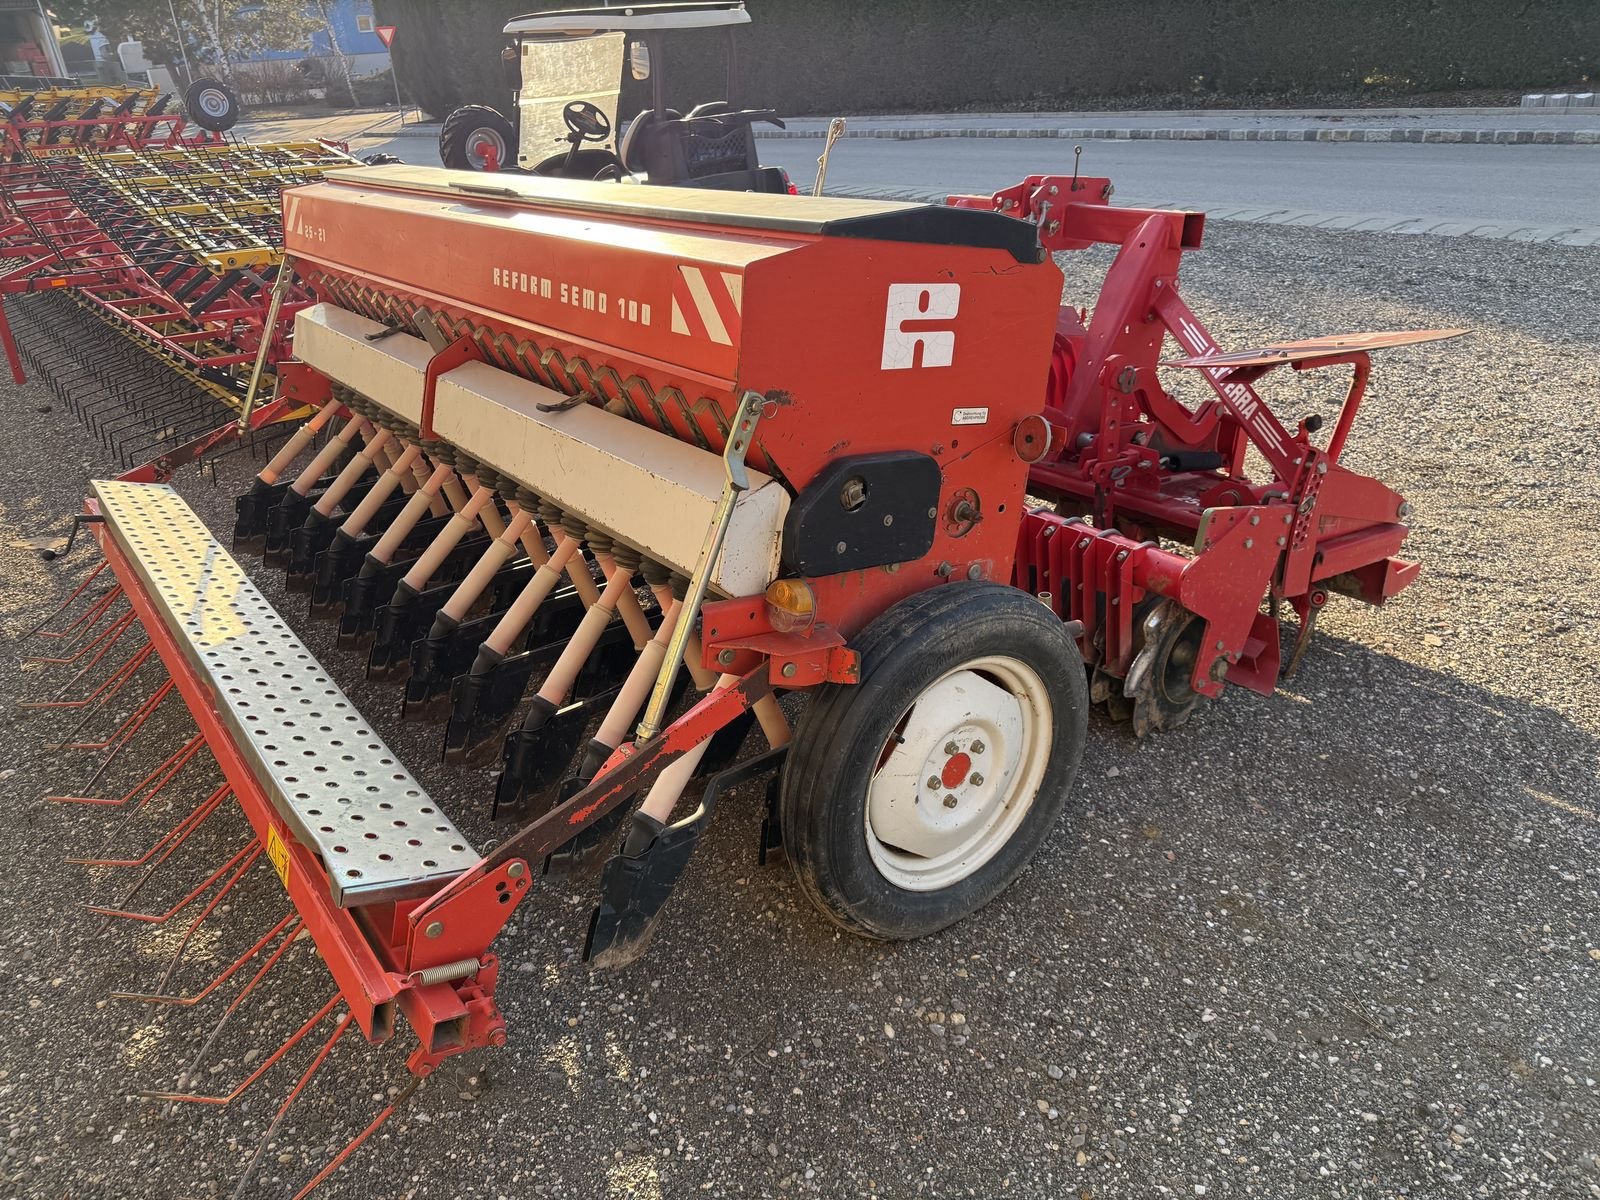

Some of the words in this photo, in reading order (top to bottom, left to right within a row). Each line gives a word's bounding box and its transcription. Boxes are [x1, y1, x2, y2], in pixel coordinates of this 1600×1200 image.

[493, 267, 552, 299] REFORM
[560, 282, 607, 314] SEMO
[617, 298, 651, 326] 100
